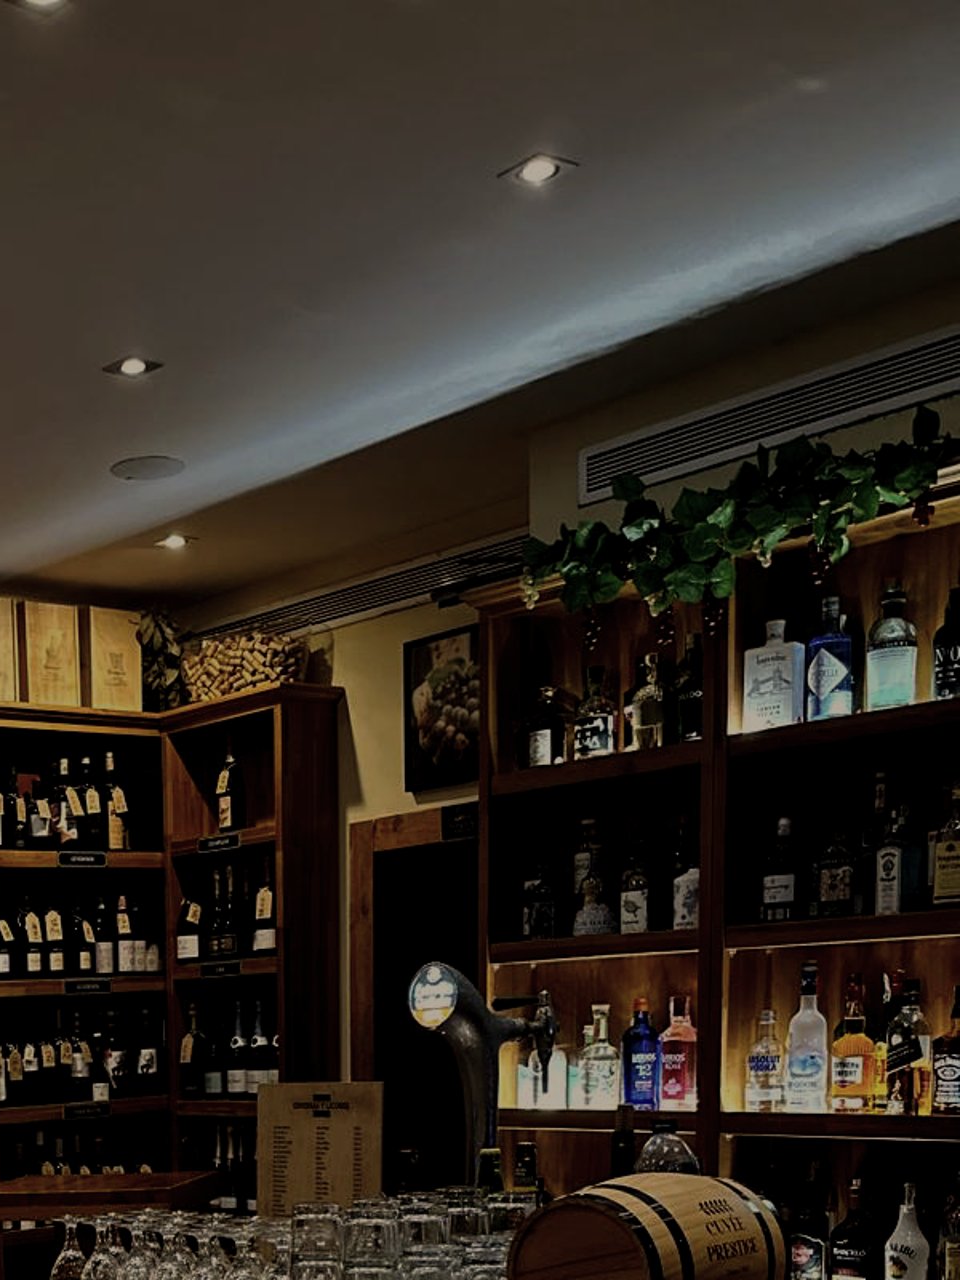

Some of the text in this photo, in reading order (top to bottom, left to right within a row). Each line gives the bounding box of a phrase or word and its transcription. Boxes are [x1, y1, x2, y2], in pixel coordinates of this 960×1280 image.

[748, 1055, 780, 1064] ABSOLUT
[749, 1063, 778, 1072] VODKA
[705, 1215, 746, 1236] CUVÉE
[706, 1236, 759, 1262] PRESTIGE
